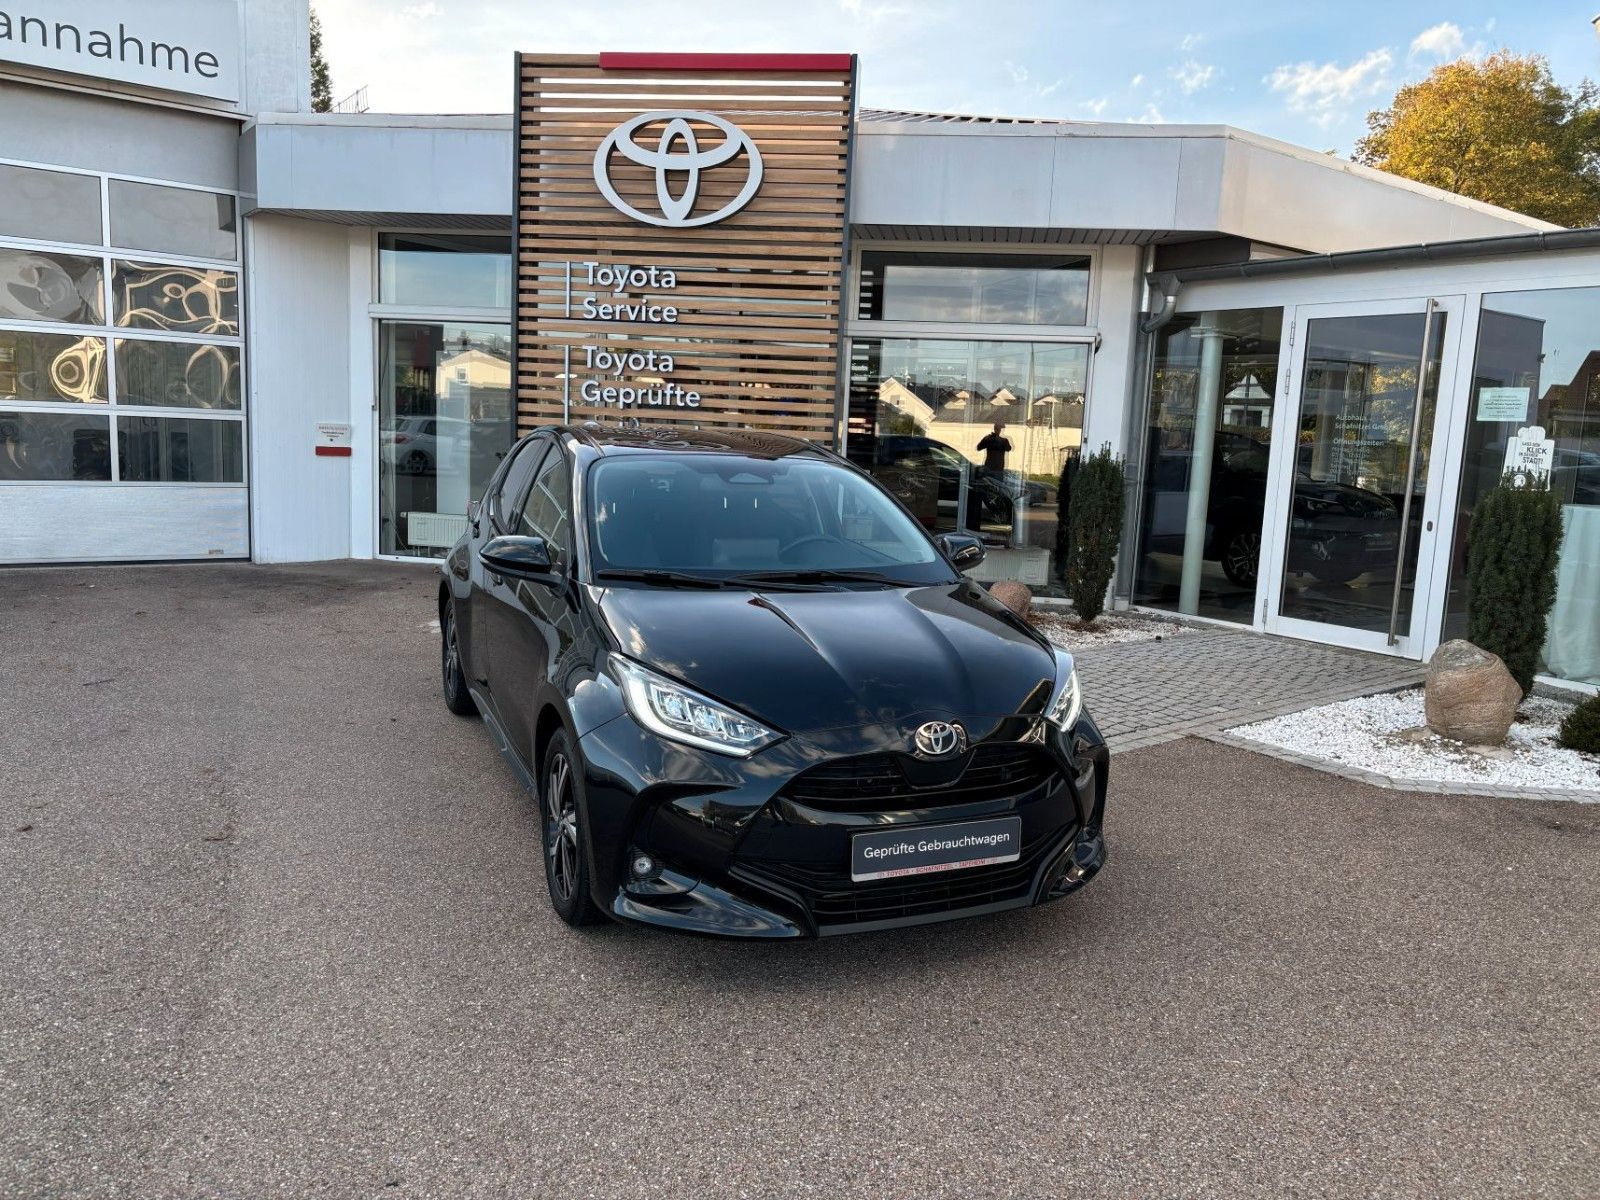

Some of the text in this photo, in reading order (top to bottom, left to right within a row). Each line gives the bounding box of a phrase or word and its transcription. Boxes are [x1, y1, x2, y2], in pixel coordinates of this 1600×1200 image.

[583, 261, 677, 293] Toyota
[583, 298, 678, 323] Service
[582, 345, 675, 376] Toyota
[581, 380, 701, 409] Geprüfte
[1526, 447, 1547, 455] KLICK
[864, 832, 1010, 859] Geprüfte Gebrauchtwagen
[887, 869, 910, 877] TOYOTA
